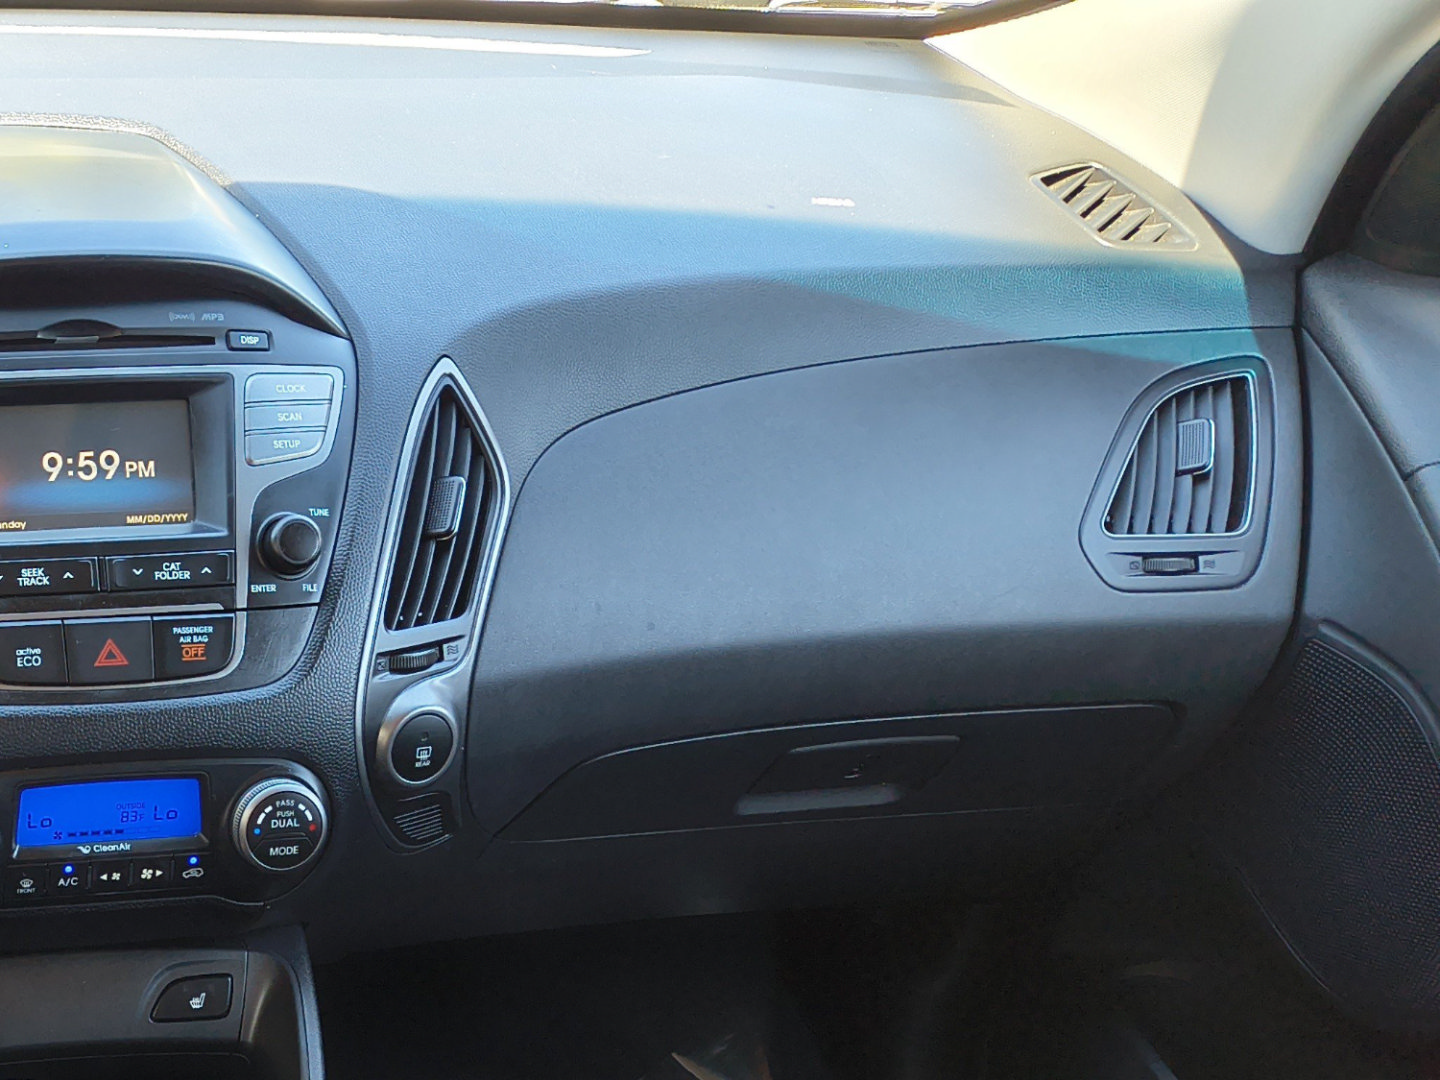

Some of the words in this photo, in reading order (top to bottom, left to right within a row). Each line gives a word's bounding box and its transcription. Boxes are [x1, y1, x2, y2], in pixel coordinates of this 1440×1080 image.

[201, 313, 224, 321] MP3
[240, 335, 260, 345] DISP
[275, 384, 306, 393] CLOCK
[277, 412, 303, 421] SCAN
[273, 440, 301, 449] SETUP
[42, 449, 120, 482] 9:59
[125, 460, 155, 478] PM
[308, 507, 329, 516] TUNE
[126, 513, 188, 524] MM/DD/YYYY
[162, 562, 181, 571] CAT
[21, 568, 45, 577] SEEK
[154, 571, 190, 580] FOLDER
[17, 576, 49, 587] TRACK
[250, 584, 276, 593] ENTER
[302, 583, 318, 592] FILE
[173, 625, 213, 634] PASSENGER
[179, 635, 192, 643] AIR
[193, 634, 208, 643] BAG
[16, 647, 41, 656] active
[182, 647, 205, 658] OFF
[17, 655, 42, 667] ECO
[116, 802, 145, 810] OUTSIDE
[276, 799, 295, 808] PASS
[153, 805, 178, 820] Lo
[276, 810, 295, 818] PUSH
[27, 813, 52, 829] Lo
[271, 819, 299, 828] DUAL
[93, 843, 131, 852] CleanAir
[269, 846, 299, 856] MODE
[58, 876, 79, 887] A/C
